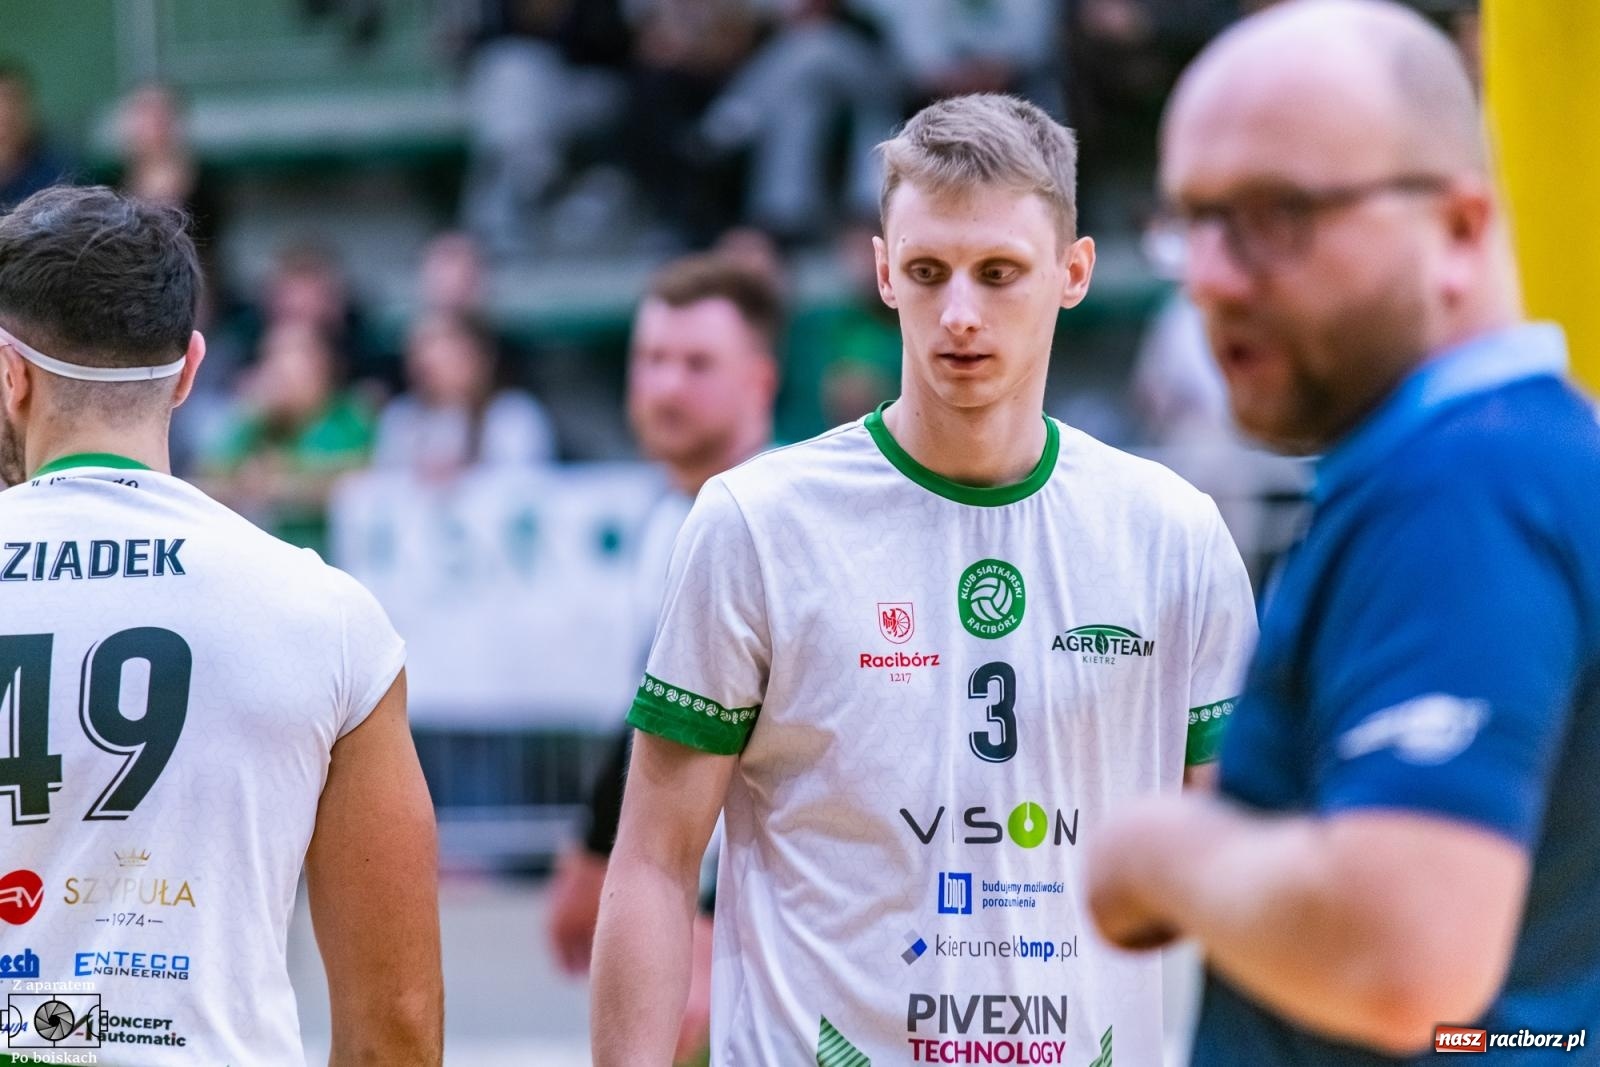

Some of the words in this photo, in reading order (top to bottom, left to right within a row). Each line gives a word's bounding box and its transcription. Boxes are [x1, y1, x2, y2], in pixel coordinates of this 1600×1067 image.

[0, 538, 186, 581] ZIADEK
[961, 573, 977, 600] KLUB
[976, 565, 1023, 598] SIATKARSKI
[967, 614, 1018, 634] RACIBÓRZ
[860, 651, 940, 669] Racibórz
[1082, 655, 1116, 665] KIETRZ
[890, 672, 912, 684] 1217
[968, 661, 1018, 763] 3
[0, 626, 193, 826] 49
[899, 801, 1079, 849] VSON
[64, 877, 196, 908] SZYPUŁA
[112, 913, 145, 927] 1974
[935, 934, 1079, 962] kierunekbmp.pl
[74, 951, 190, 976] ENTECO
[99, 1015, 173, 1031] CONCEPT
[907, 993, 1068, 1035] PIVEXIN
[98, 1031, 187, 1047] automatic
[908, 1038, 1066, 1064] TECHNOLOGY
